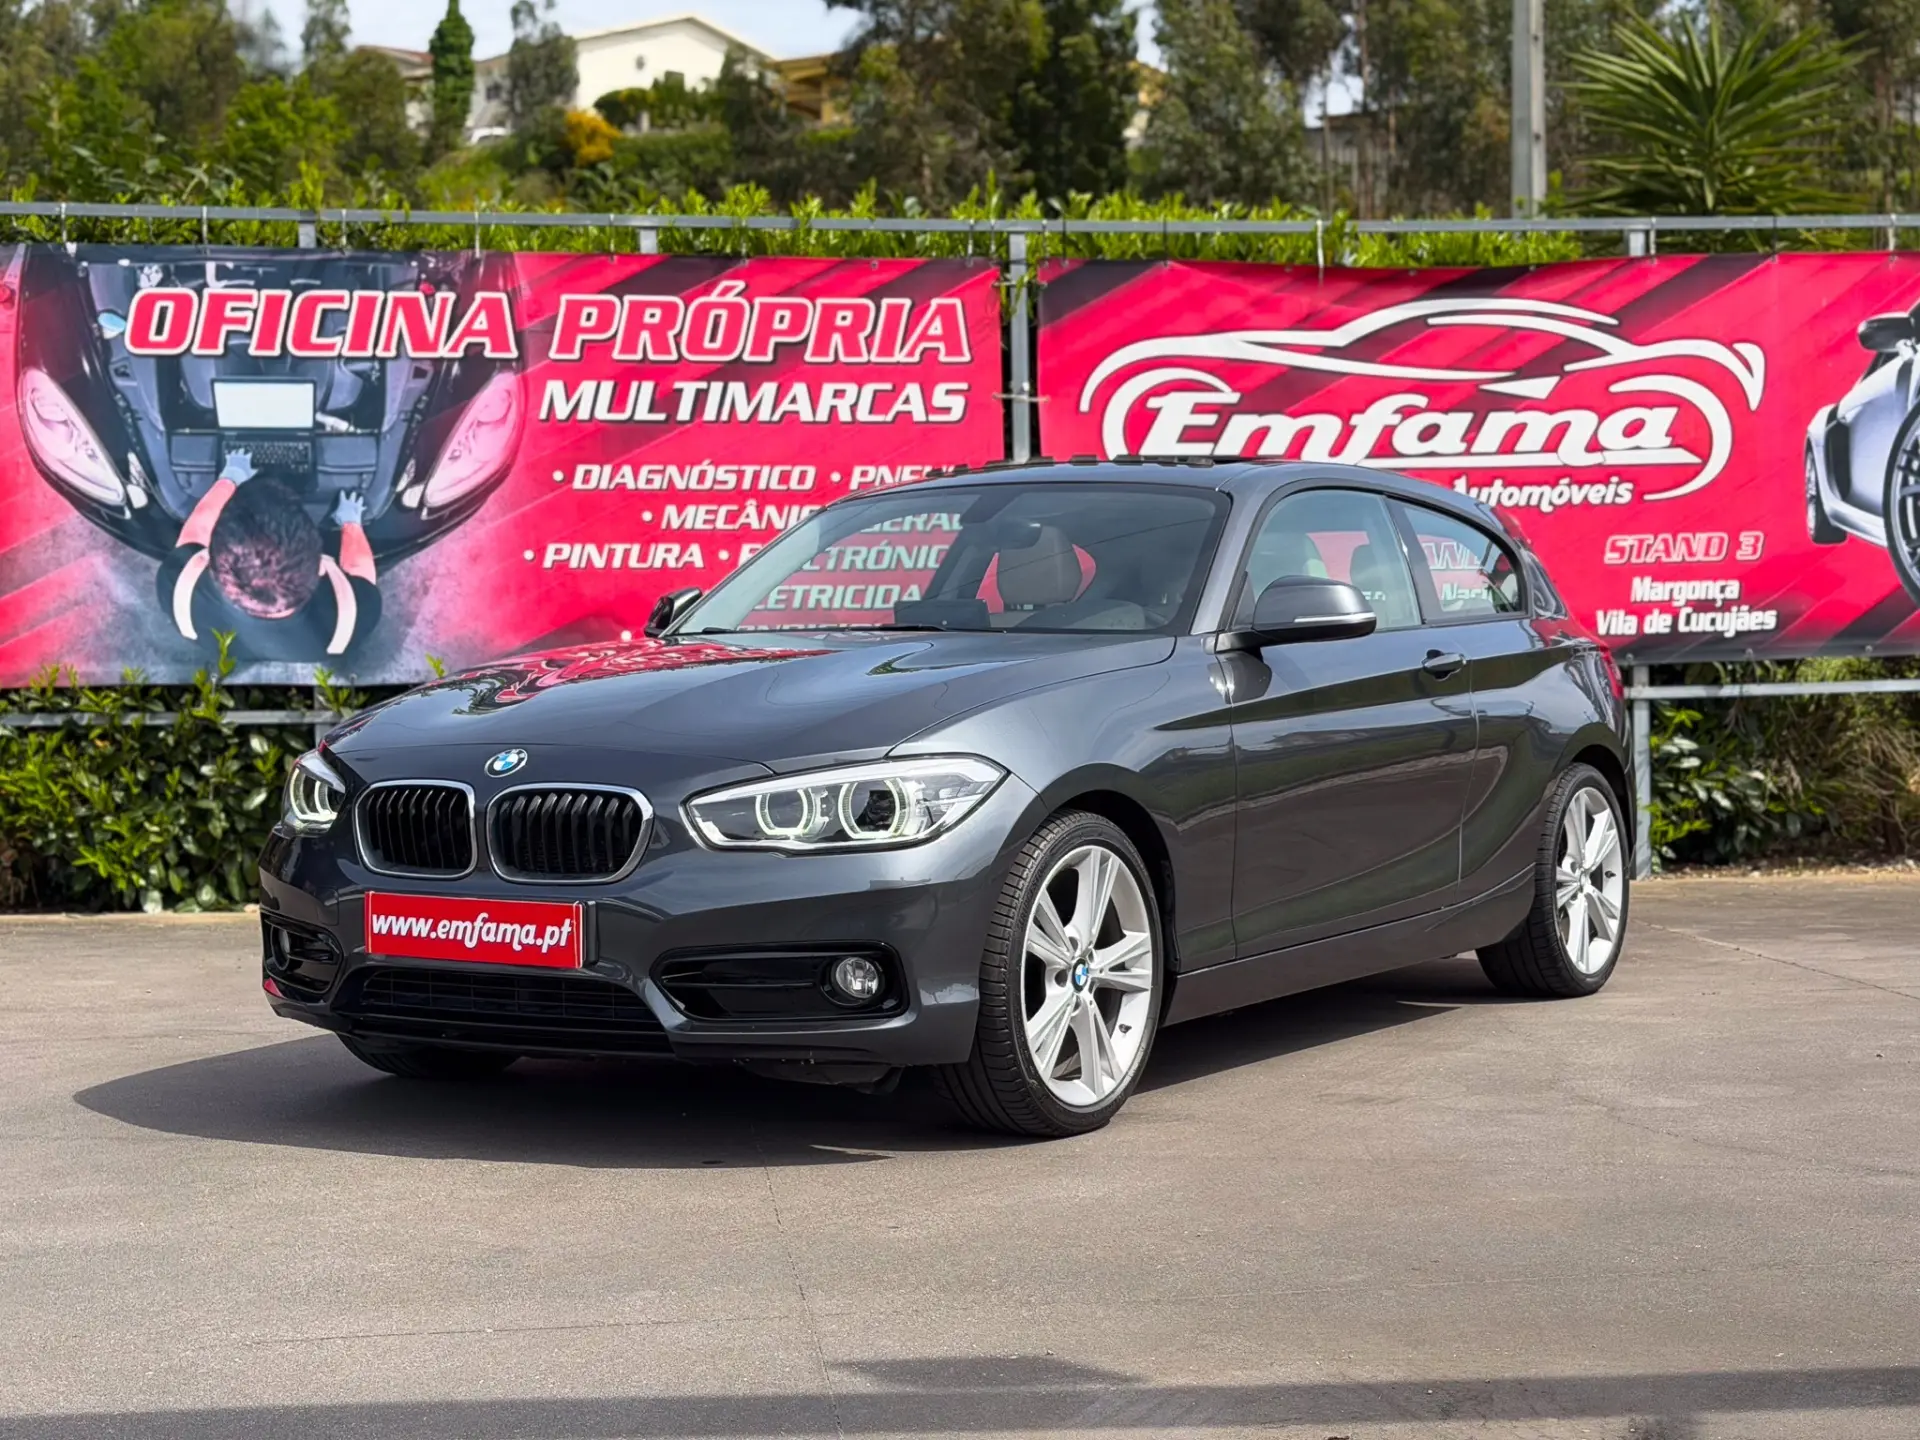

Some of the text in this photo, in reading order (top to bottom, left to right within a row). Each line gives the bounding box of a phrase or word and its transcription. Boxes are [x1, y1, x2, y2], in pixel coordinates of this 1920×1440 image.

[124, 280, 972, 364] OFICINA PRÓPRIA
[538, 379, 969, 423] MULTIMARCAS
[1141, 390, 1680, 467] Emfama
[572, 459, 955, 492] DIAGNÓSTICO PNE
[860, 512, 964, 533] ERAL
[542, 543, 705, 569] PINTURA
[1603, 530, 1765, 565] STAND 3
[1630, 575, 1741, 608] Margonça
[1595, 604, 1778, 639] Vila de Cucujães
[371, 912, 573, 954] www.emfama.pt
